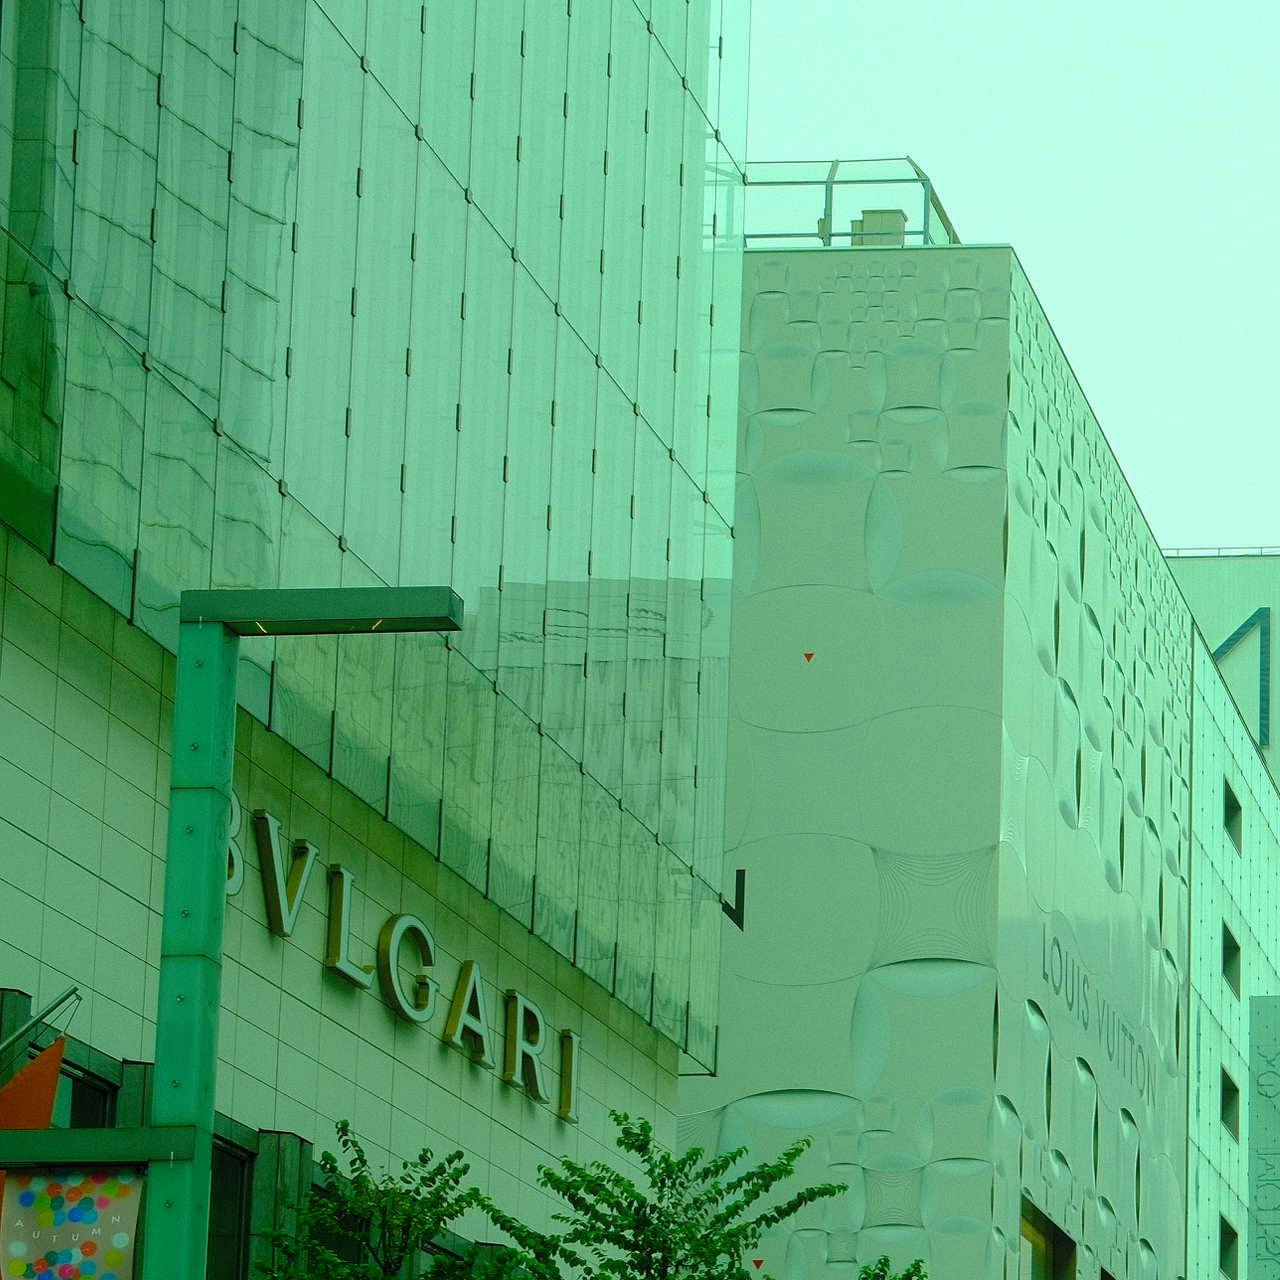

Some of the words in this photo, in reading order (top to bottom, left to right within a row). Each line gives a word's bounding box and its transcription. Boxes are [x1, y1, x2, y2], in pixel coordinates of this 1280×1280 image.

[1040, 921, 1090, 1032] LOUIS
[1095, 988, 1158, 1113] VUITTON
[13, 1215, 121, 1243] AUTUMN
